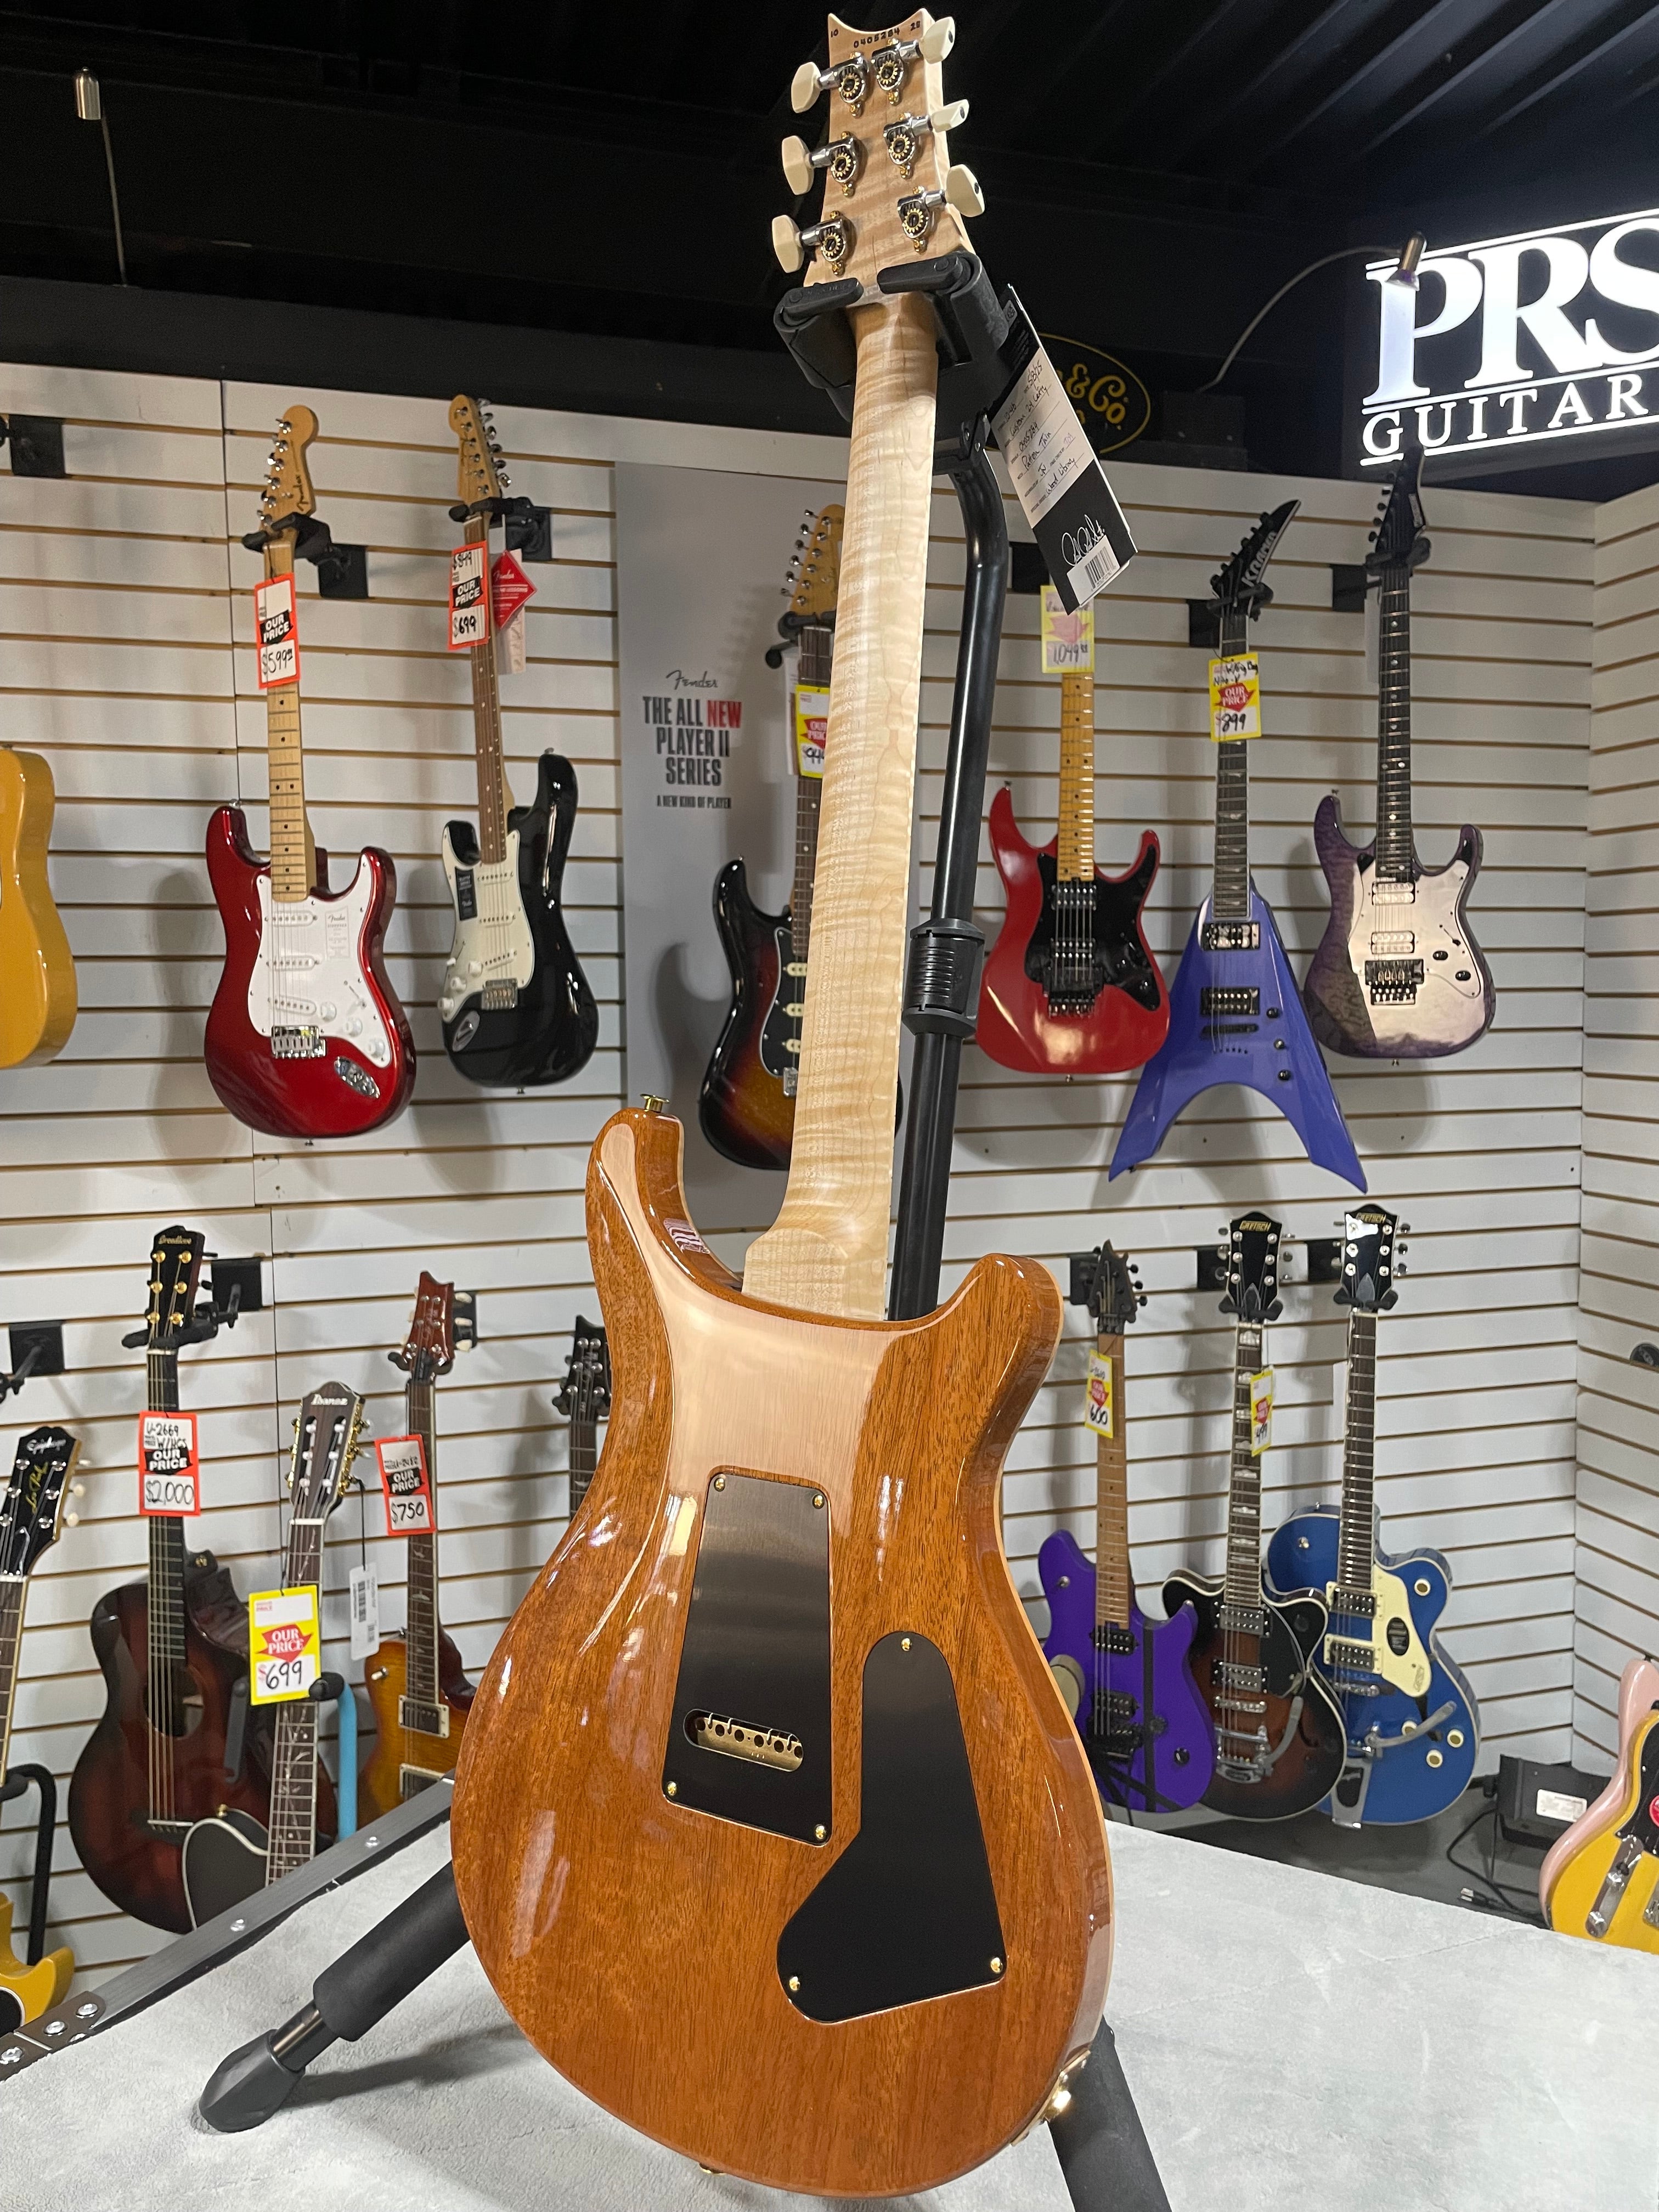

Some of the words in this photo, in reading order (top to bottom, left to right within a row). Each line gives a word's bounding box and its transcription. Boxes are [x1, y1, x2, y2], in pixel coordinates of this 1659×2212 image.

[831, 29, 839, 38] 10
[1363, 219, 1659, 406] PRS
[1363, 373, 1649, 456] GUITAR
[458, 579, 476, 595] OUR
[455, 587, 481, 607] PRICE
[266, 614, 284, 629] OUR
[263, 621, 290, 644] PRICE
[666, 670, 718, 690] Fender
[1225, 686, 1245, 697] OUR
[1222, 693, 1248, 706] PRICE
[643, 696, 672, 724] THE
[676, 698, 703, 726] ALL
[707, 700, 742, 729] NEW
[656, 727, 715, 757] PLAYER
[719, 730, 730, 757] II
[666, 757, 721, 786] SERIES
[663, 795, 678, 807] NEW
[707, 797, 731, 809] PLAYER
[1239, 1220, 1271, 1232] GRETSCH
[311, 1394, 348, 1406] Ibanez
[153, 1449, 180, 1461] OUR
[149, 1458, 188, 1471] PRICE
[393, 1470, 414, 1483] OUR
[391, 1478, 420, 1493] PRICE
[391, 1502, 424, 1525] $750
[272, 1628, 299, 1642] OUR
[268, 1638, 304, 1655] PRICE
